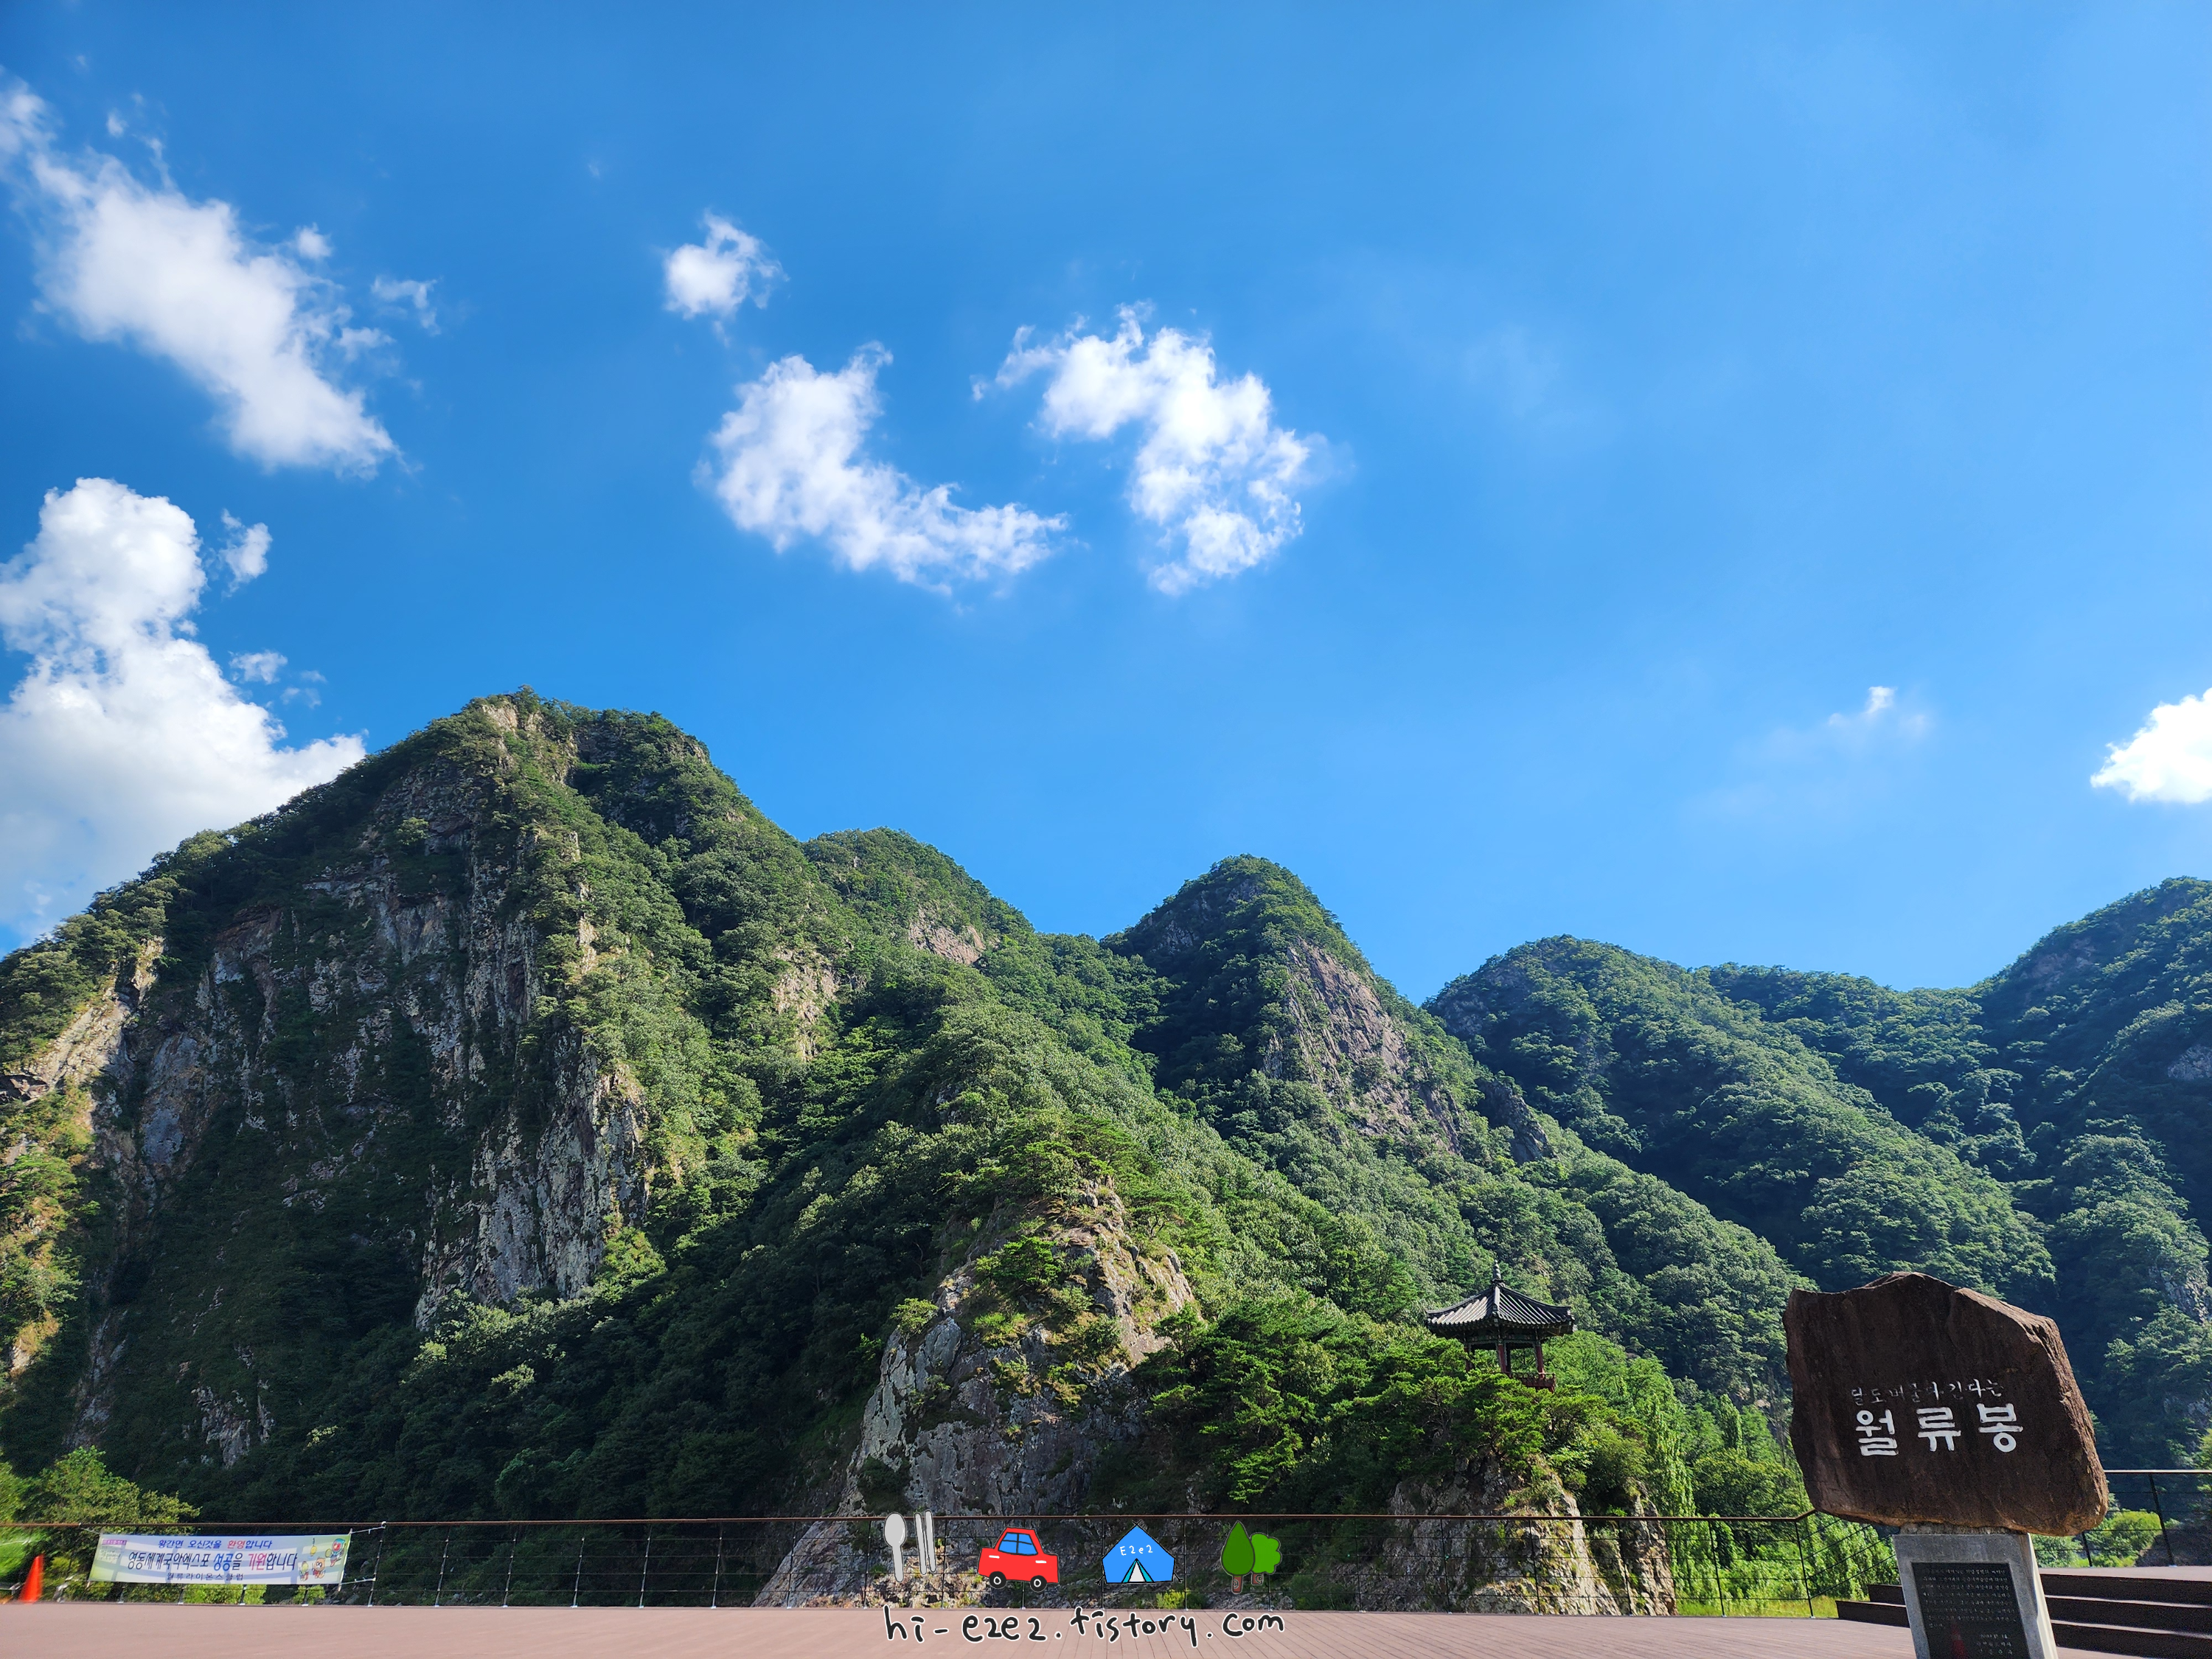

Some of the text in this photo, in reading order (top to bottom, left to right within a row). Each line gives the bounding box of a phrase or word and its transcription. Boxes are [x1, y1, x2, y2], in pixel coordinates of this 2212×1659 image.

[1855, 1403, 2023, 1456] 월류봉
[159, 1540, 273, 1549] 황간면 오신것을 환영합니다
[128, 1551, 211, 1570] 영동세계국악엑스포
[213, 1553, 243, 1571] 성공을
[248, 1553, 298, 1571] 기원합니다
